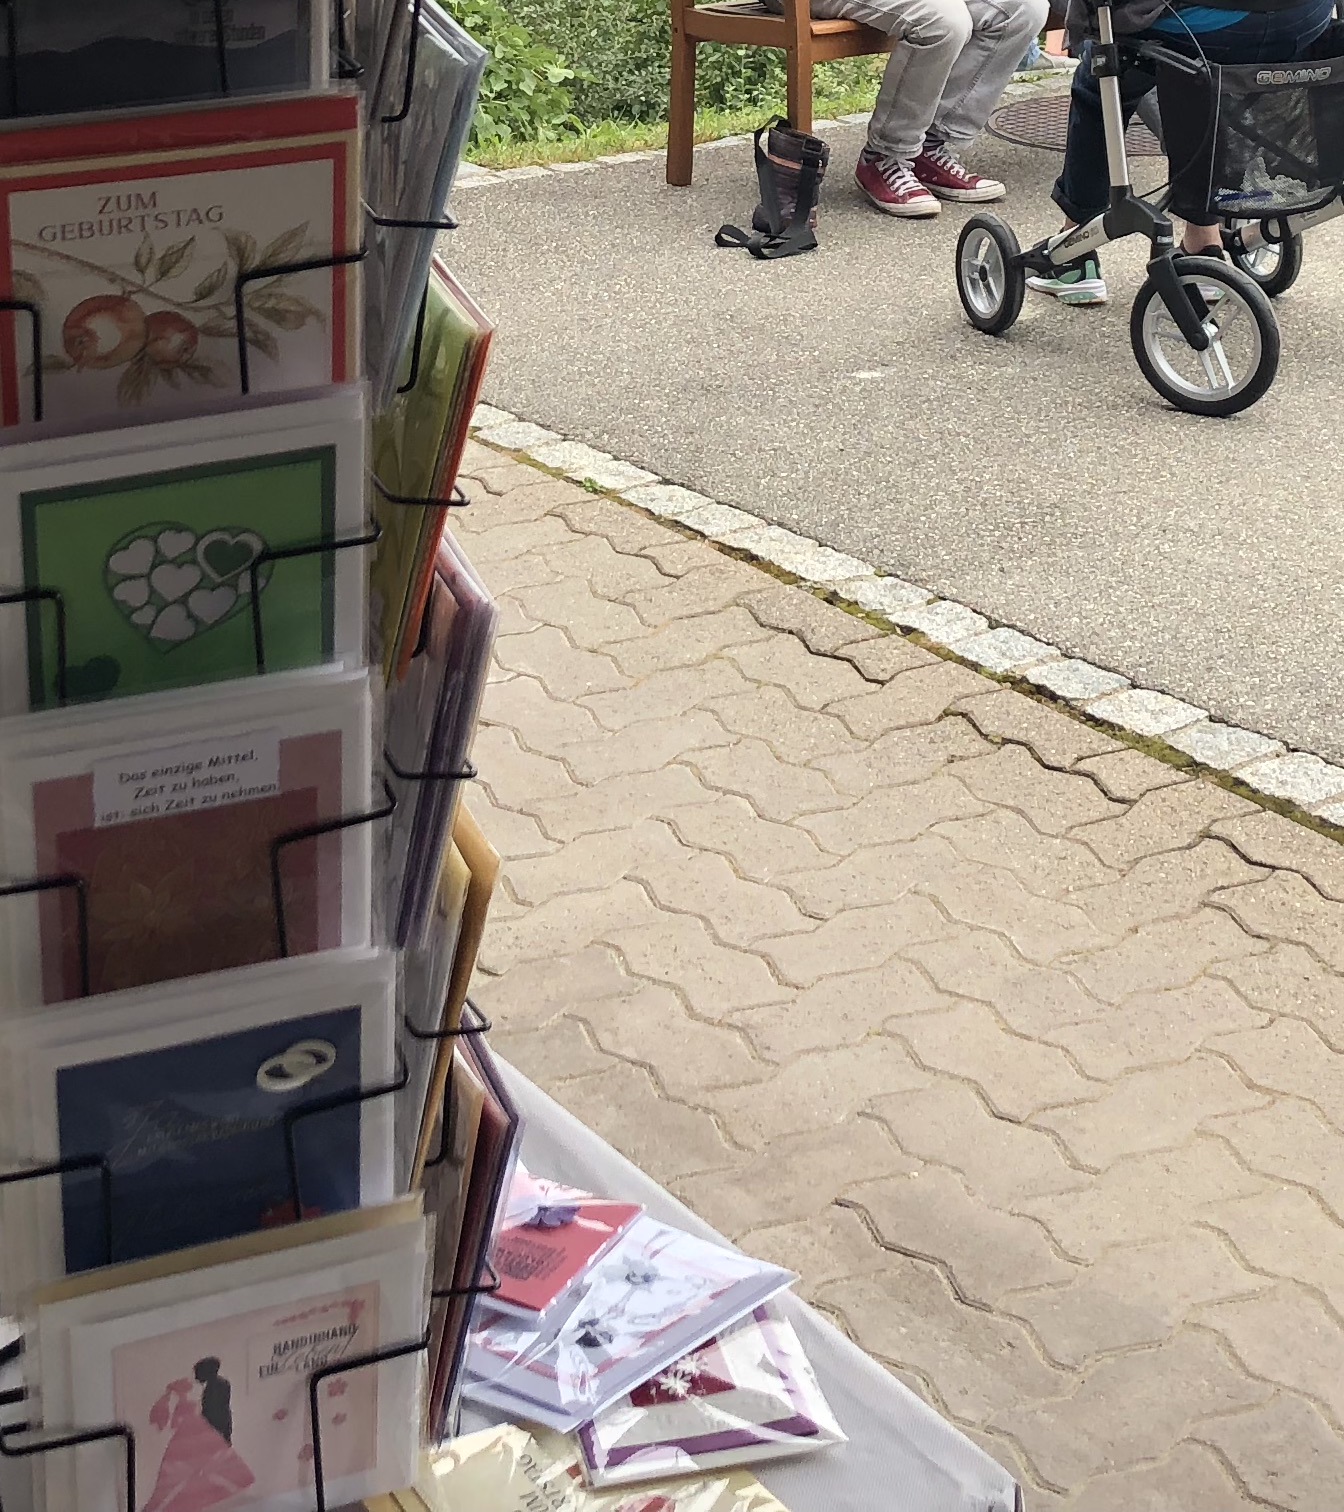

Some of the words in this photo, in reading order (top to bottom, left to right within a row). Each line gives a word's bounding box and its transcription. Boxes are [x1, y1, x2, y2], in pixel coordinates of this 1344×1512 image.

[97, 190, 158, 216] ZUM
[38, 205, 224, 243] GEBURTSTAG
[119, 769, 147, 785] Das
[151, 760, 203, 778] einzige
[207, 749, 258, 768] Mittel,
[134, 784, 166, 800] Zeit
[171, 782, 187, 792] zu
[192, 772, 240, 788] haben,
[130, 803, 160, 817] sich
[165, 797, 195, 812] Zeit
[201, 793, 217, 804] zu
